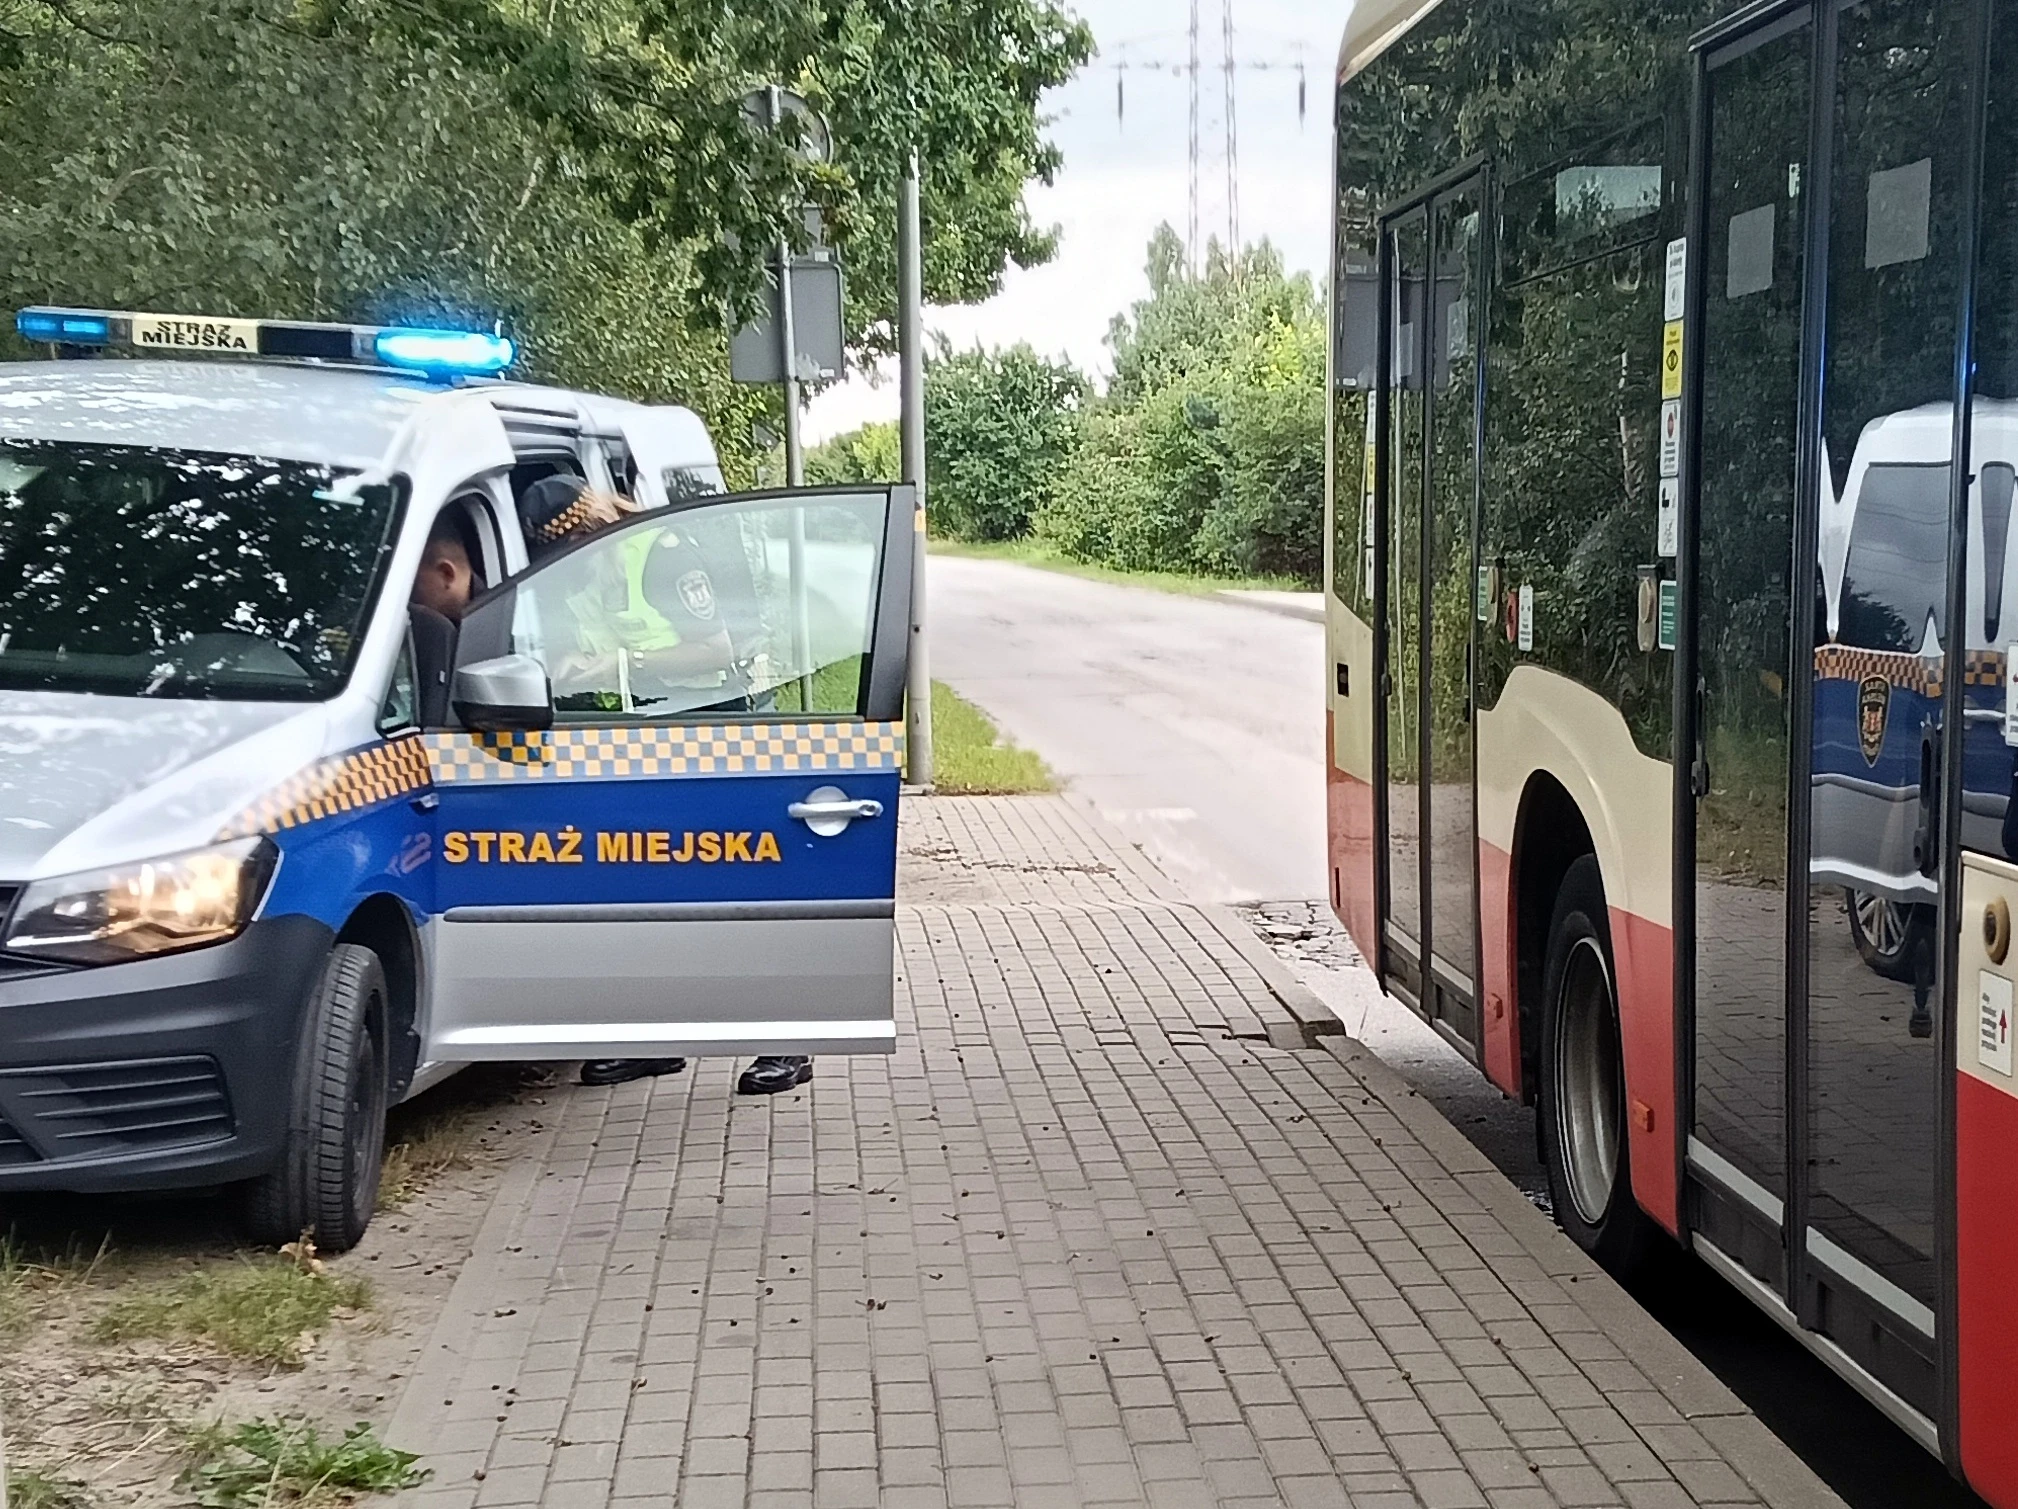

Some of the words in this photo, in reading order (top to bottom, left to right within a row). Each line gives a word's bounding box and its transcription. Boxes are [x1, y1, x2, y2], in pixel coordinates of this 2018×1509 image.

[141, 330, 248, 349] MIEJSKA
[443, 825, 583, 863] STRAŻ
[596, 831, 782, 863] MIEJSKA
